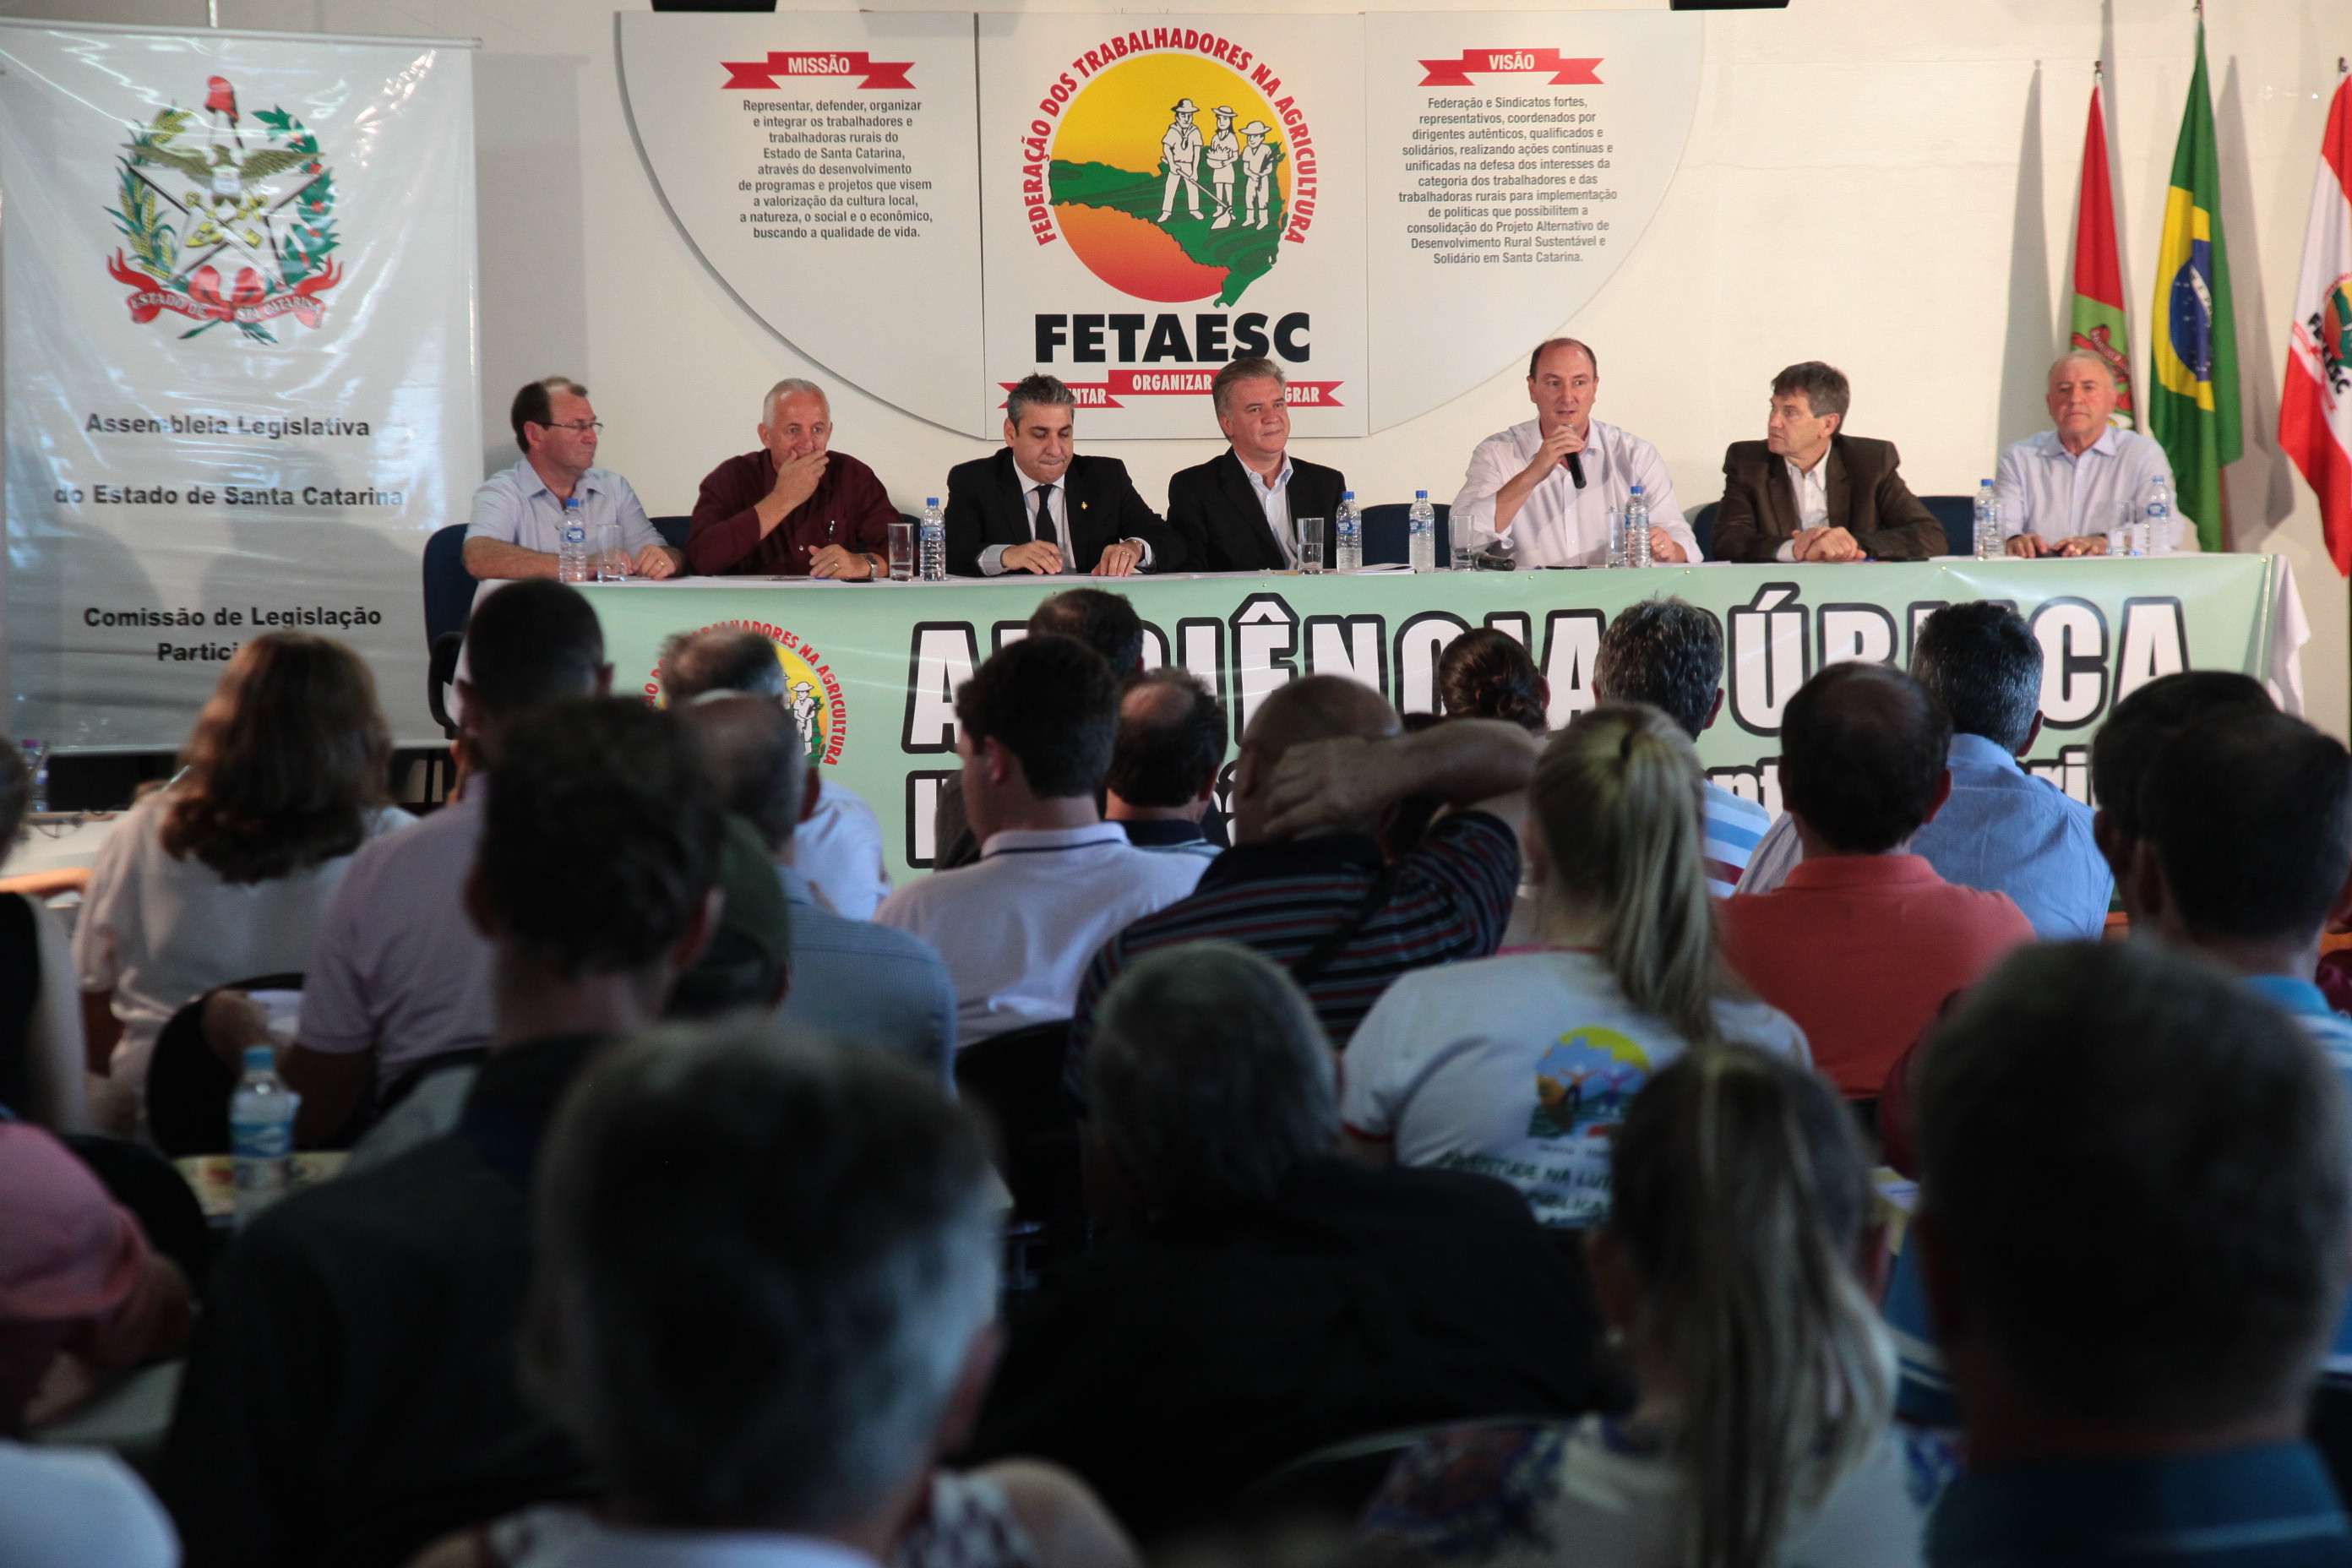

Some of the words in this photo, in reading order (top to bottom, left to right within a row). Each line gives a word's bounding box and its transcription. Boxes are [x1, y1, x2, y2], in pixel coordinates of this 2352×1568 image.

[788, 54, 850, 74] MISSÃO
[1489, 52, 1534, 69] VISÃO
[743, 100, 812, 113] Representar,
[816, 100, 866, 112] defender,
[870, 100, 922, 113] organizar
[1429, 97, 1483, 111] Federação
[1495, 97, 1550, 107] Sindicatos
[1554, 96, 1587, 108] fortes,
[754, 118, 760, 127] e
[764, 116, 807, 129] integrar
[810, 118, 823, 127] os
[827, 116, 903, 127] trabalhadores
[906, 118, 912, 127] e
[1419, 113, 1504, 126] representativos,
[1507, 112, 1576, 122] coordenados
[1579, 114, 1596, 124] por
[769, 132, 846, 143] trabalhadoras
[850, 132, 881, 142] rurais
[885, 132, 898, 142] do
[1021, 119, 1057, 246] FEDERAÇÃO
[1043, 72, 1078, 117] DOS
[1073, 27, 1254, 79] TRABALHADORES
[1250, 63, 1282, 99] NA
[1275, 95, 1317, 245] AGRICULTURA
[1413, 129, 1465, 142] dirigentes
[1468, 128, 1527, 140] autênticos,
[1529, 128, 1594, 140] qualificados
[764, 148, 801, 159] Estado
[804, 148, 817, 159] de
[821, 148, 852, 159] Santa
[856, 148, 905, 160] Catarina,
[1402, 144, 1456, 156] solidários,
[1460, 144, 1515, 155] realizando
[1518, 144, 1549, 156] ações
[1607, 144, 1613, 153] e
[758, 164, 798, 175] através
[803, 164, 815, 174] do
[819, 163, 912, 174] desenvolvimento
[1406, 161, 1460, 171] unificadas
[1480, 160, 1515, 170] defesa
[1518, 159, 1537, 169] dos
[1540, 159, 1594, 169] interesses
[1598, 158, 1610, 168] da
[738, 180, 752, 190] de
[755, 182, 815, 193] programas
[819, 182, 825, 190] e
[829, 179, 873, 193] projetos
[876, 182, 896, 192] que
[900, 179, 932, 189] visem
[1418, 176, 1467, 188] categoria
[1471, 176, 1490, 186] dos
[1493, 174, 1566, 185] trabalhadores
[1579, 174, 1598, 184] das
[754, 198, 760, 206] a
[764, 195, 826, 209] valorização
[830, 195, 843, 206] da
[847, 195, 885, 205] cultura
[889, 194, 917, 207] local,
[1399, 191, 1473, 202] trabalhadoras
[1476, 190, 1506, 201] rurais
[1510, 193, 1533, 203] para
[1537, 189, 1617, 202] implementação
[740, 214, 746, 222] a
[750, 212, 801, 223] natureza,
[804, 214, 811, 222] o
[814, 211, 847, 222] social
[851, 213, 857, 221] e
[860, 213, 866, 221] o
[870, 210, 932, 222] econômico,
[1429, 207, 1440, 217] de
[1492, 209, 1511, 219] que
[1515, 205, 1578, 218] possibilitem
[754, 227, 807, 238] buscando
[811, 229, 817, 237] a
[820, 226, 874, 240] qualidade
[878, 226, 890, 237] de
[895, 226, 920, 237] vida.
[1407, 222, 1477, 235] consolidação
[1480, 222, 1493, 231] do
[1496, 221, 1533, 234] Projeto
[1536, 220, 1593, 231] Alternativo
[1597, 220, 1609, 231] de
[1412, 237, 1500, 248] Desenvolvimento
[1505, 237, 1532, 247] Rural
[1535, 236, 1596, 247] Sustentável
[1599, 237, 1605, 246] e
[1434, 253, 1480, 264] Solidário
[1503, 253, 1533, 263] Santa
[1536, 252, 1583, 262] Catarina.
[1035, 313, 1310, 362] FETAESC
[1133, 374, 1212, 390] ORGANIZAR
[237, 416, 370, 440] Legislativa
[54, 485, 84, 504] do
[94, 485, 177, 505] Estado
[187, 486, 215, 506] de
[224, 487, 294, 506] Santa
[302, 487, 404, 506] Catarina
[84, 607, 204, 628] Comissão
[214, 607, 242, 627] de
[252, 607, 381, 629] Legislação
[798, 644, 820, 666] NA
[815, 665, 847, 765] AGRICULTURA
